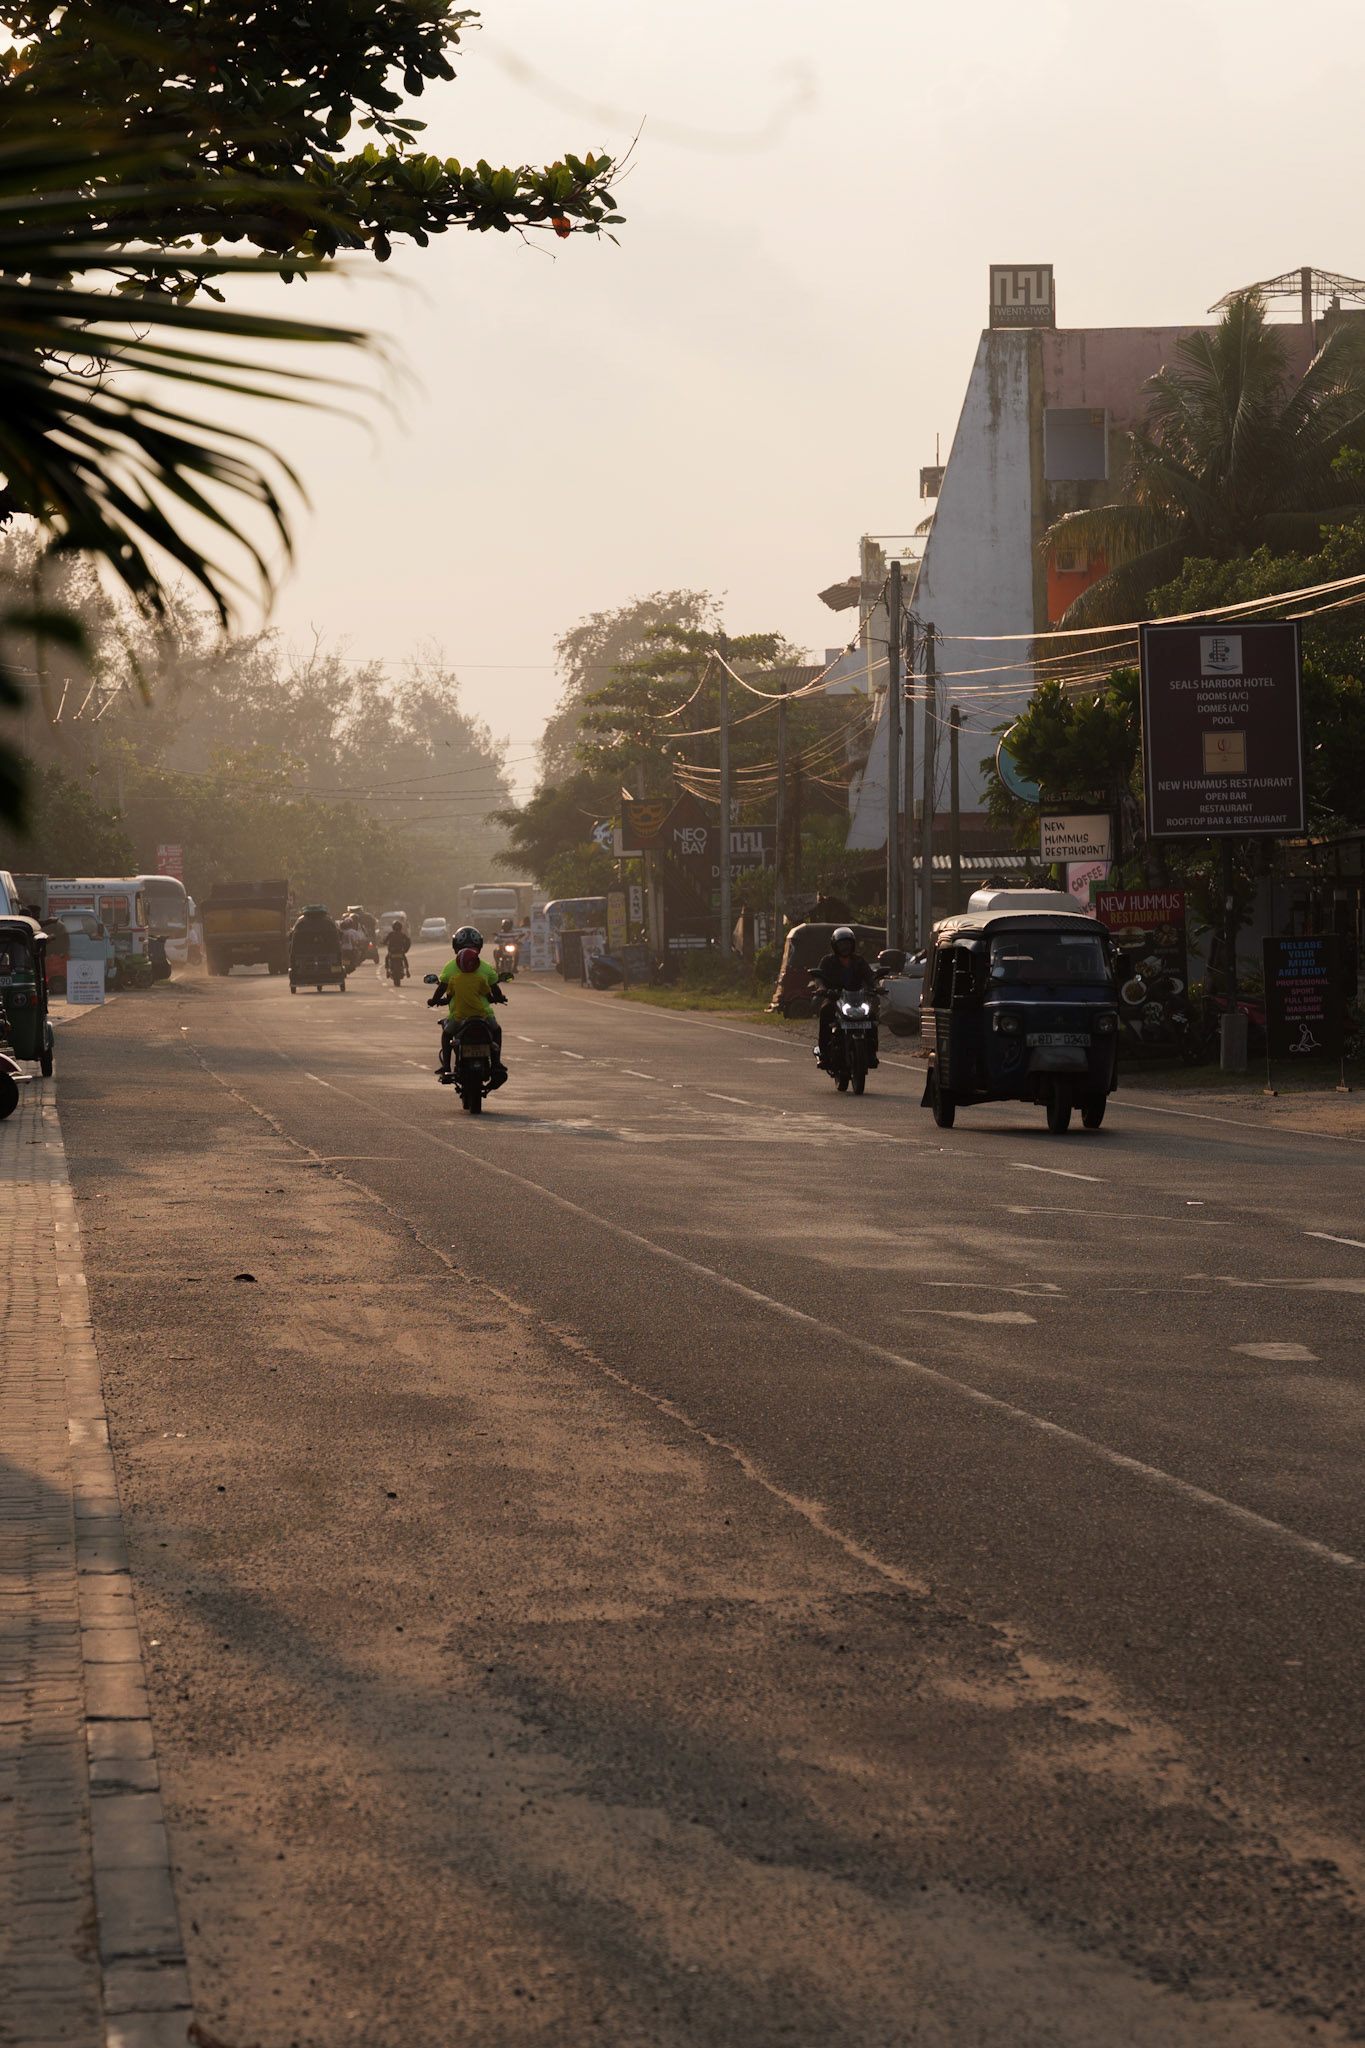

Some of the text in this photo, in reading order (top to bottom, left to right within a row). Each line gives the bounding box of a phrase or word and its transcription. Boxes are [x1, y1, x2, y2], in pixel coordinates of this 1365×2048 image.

[995, 306, 1050, 316] TWENTY-TWO
[1169, 678, 1275, 690] SEALS HARBOR HOTEL
[1197, 691, 1249, 701] ROOMS (A/C)
[1197, 703, 1249, 713] DOMES (A/C)
[1212, 716, 1235, 725] POOL
[1158, 777, 1293, 791] NEW HUMMUS RESTAURANT
[1205, 791, 1246, 801] OPEN BAR
[1200, 804, 1253, 813] RESTAURANT
[1166, 815, 1287, 827] ROOFTOP BAR & RESTAURANT
[1044, 822, 1065, 832] NEW
[673, 827, 707, 842] NEO
[1045, 834, 1088, 844] HUMMUS
[681, 841, 707, 855] BAY
[1045, 844, 1106, 857] RESTAURANT
[1071, 865, 1104, 892] COFFEE
[1100, 896, 1126, 912] NEW
[1130, 894, 1180, 911] HUMMUS
[1110, 910, 1171, 924] RESTAURANT
[1288, 950, 1315, 959] YOUR
[1288, 959, 1315, 967] MIND
[1278, 967, 1327, 976] AND BODY
